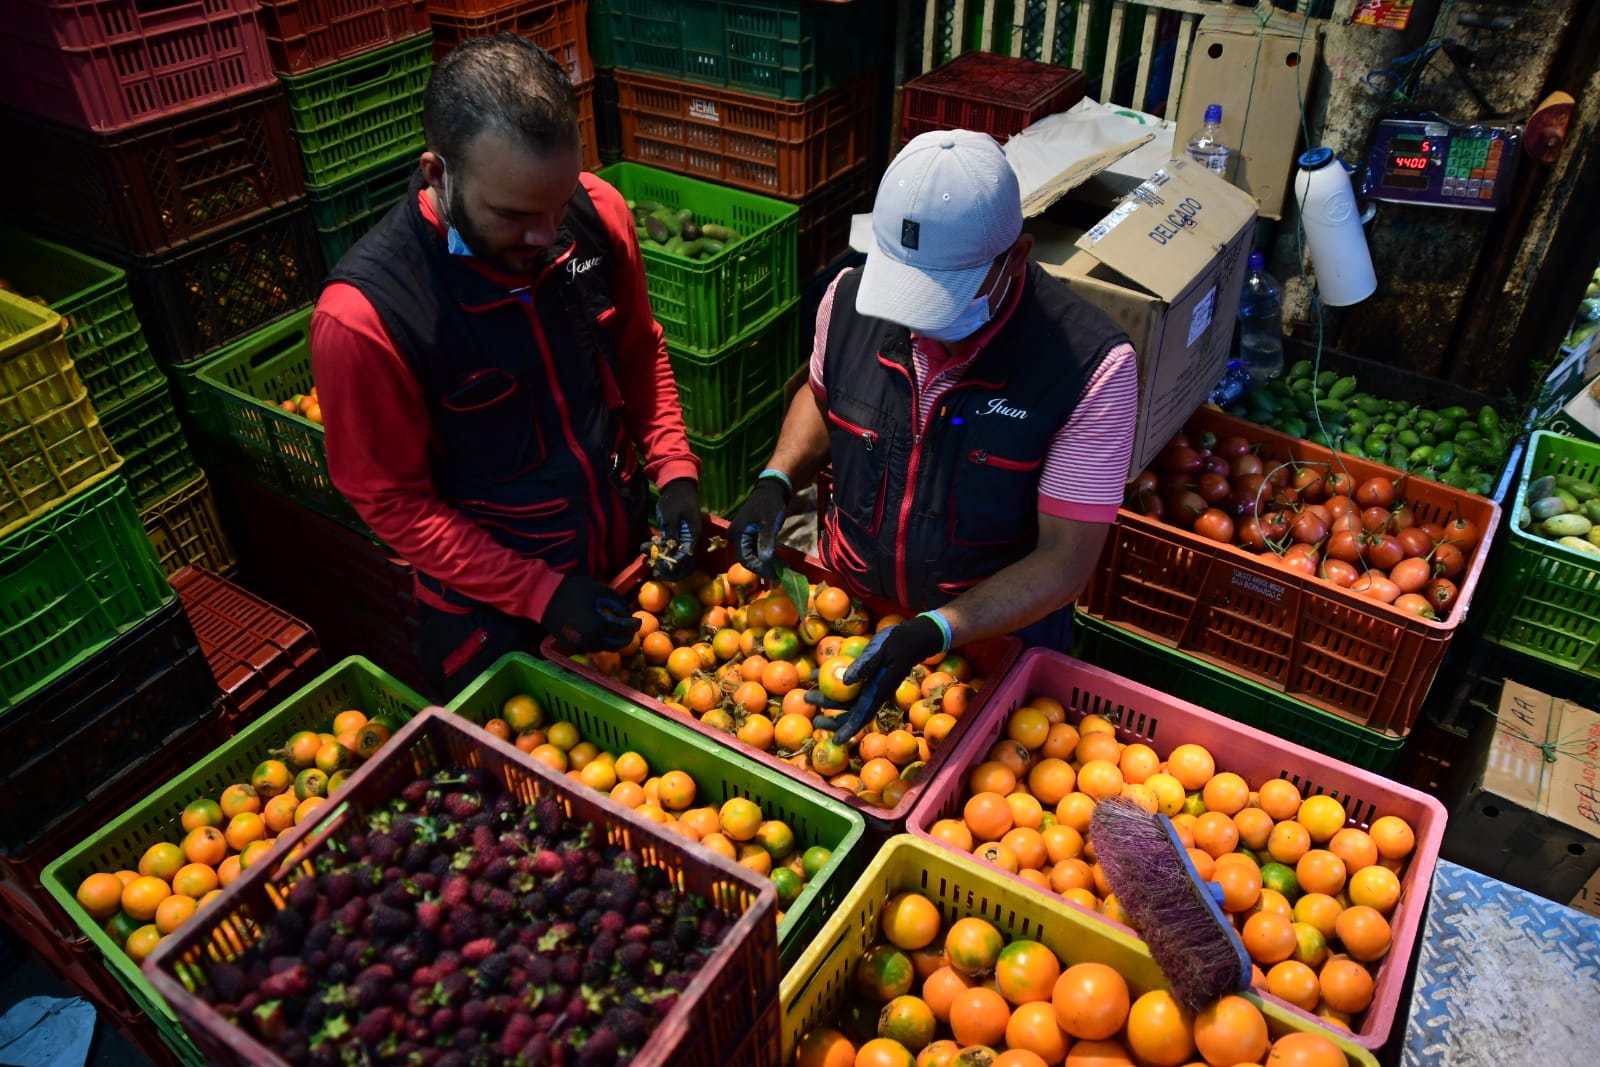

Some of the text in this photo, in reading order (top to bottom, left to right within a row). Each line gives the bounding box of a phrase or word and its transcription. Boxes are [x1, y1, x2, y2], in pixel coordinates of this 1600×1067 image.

[689, 97, 719, 116] JEML
[1395, 156, 1428, 170] 4400
[1148, 197, 1202, 245] DELICADO
[975, 398, 1028, 419] Juan
